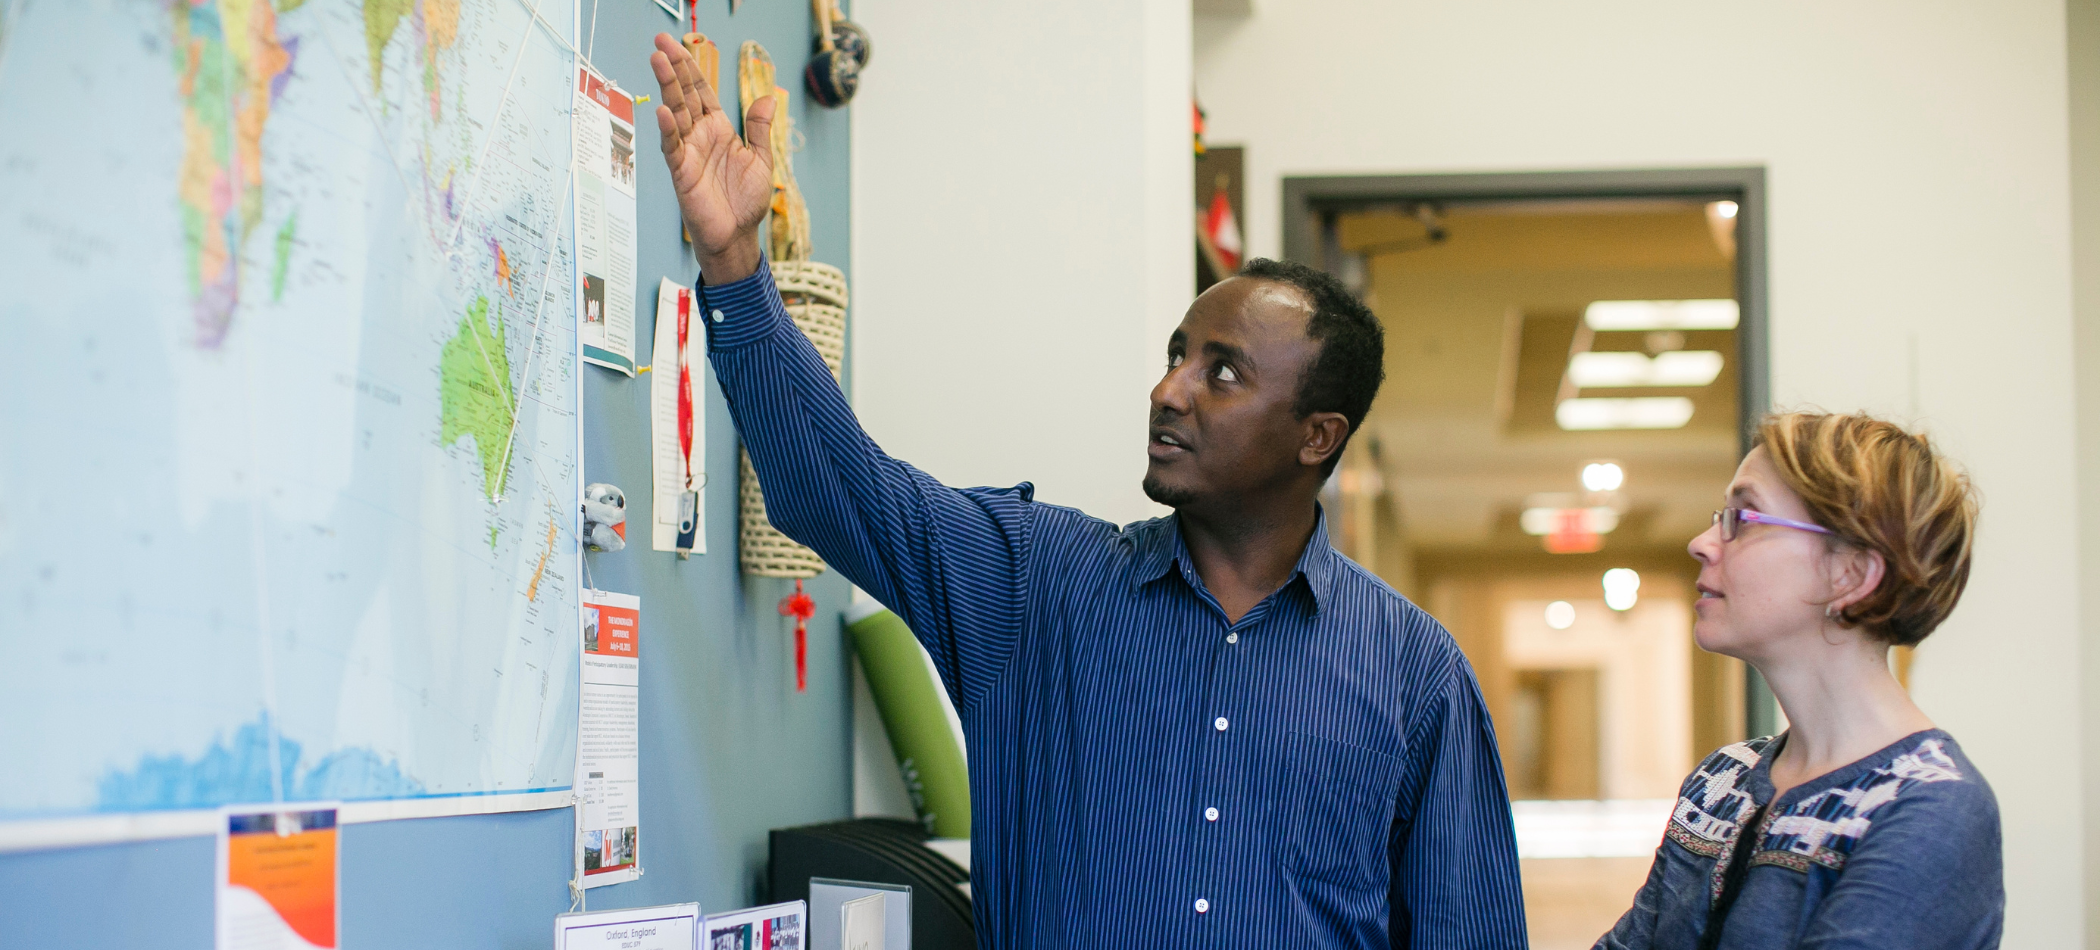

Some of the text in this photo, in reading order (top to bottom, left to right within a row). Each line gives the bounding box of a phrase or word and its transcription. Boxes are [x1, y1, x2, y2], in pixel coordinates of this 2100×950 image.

[468, 380, 495, 397] AUSTRALIA
[606, 926, 657, 941] Oxford, England
